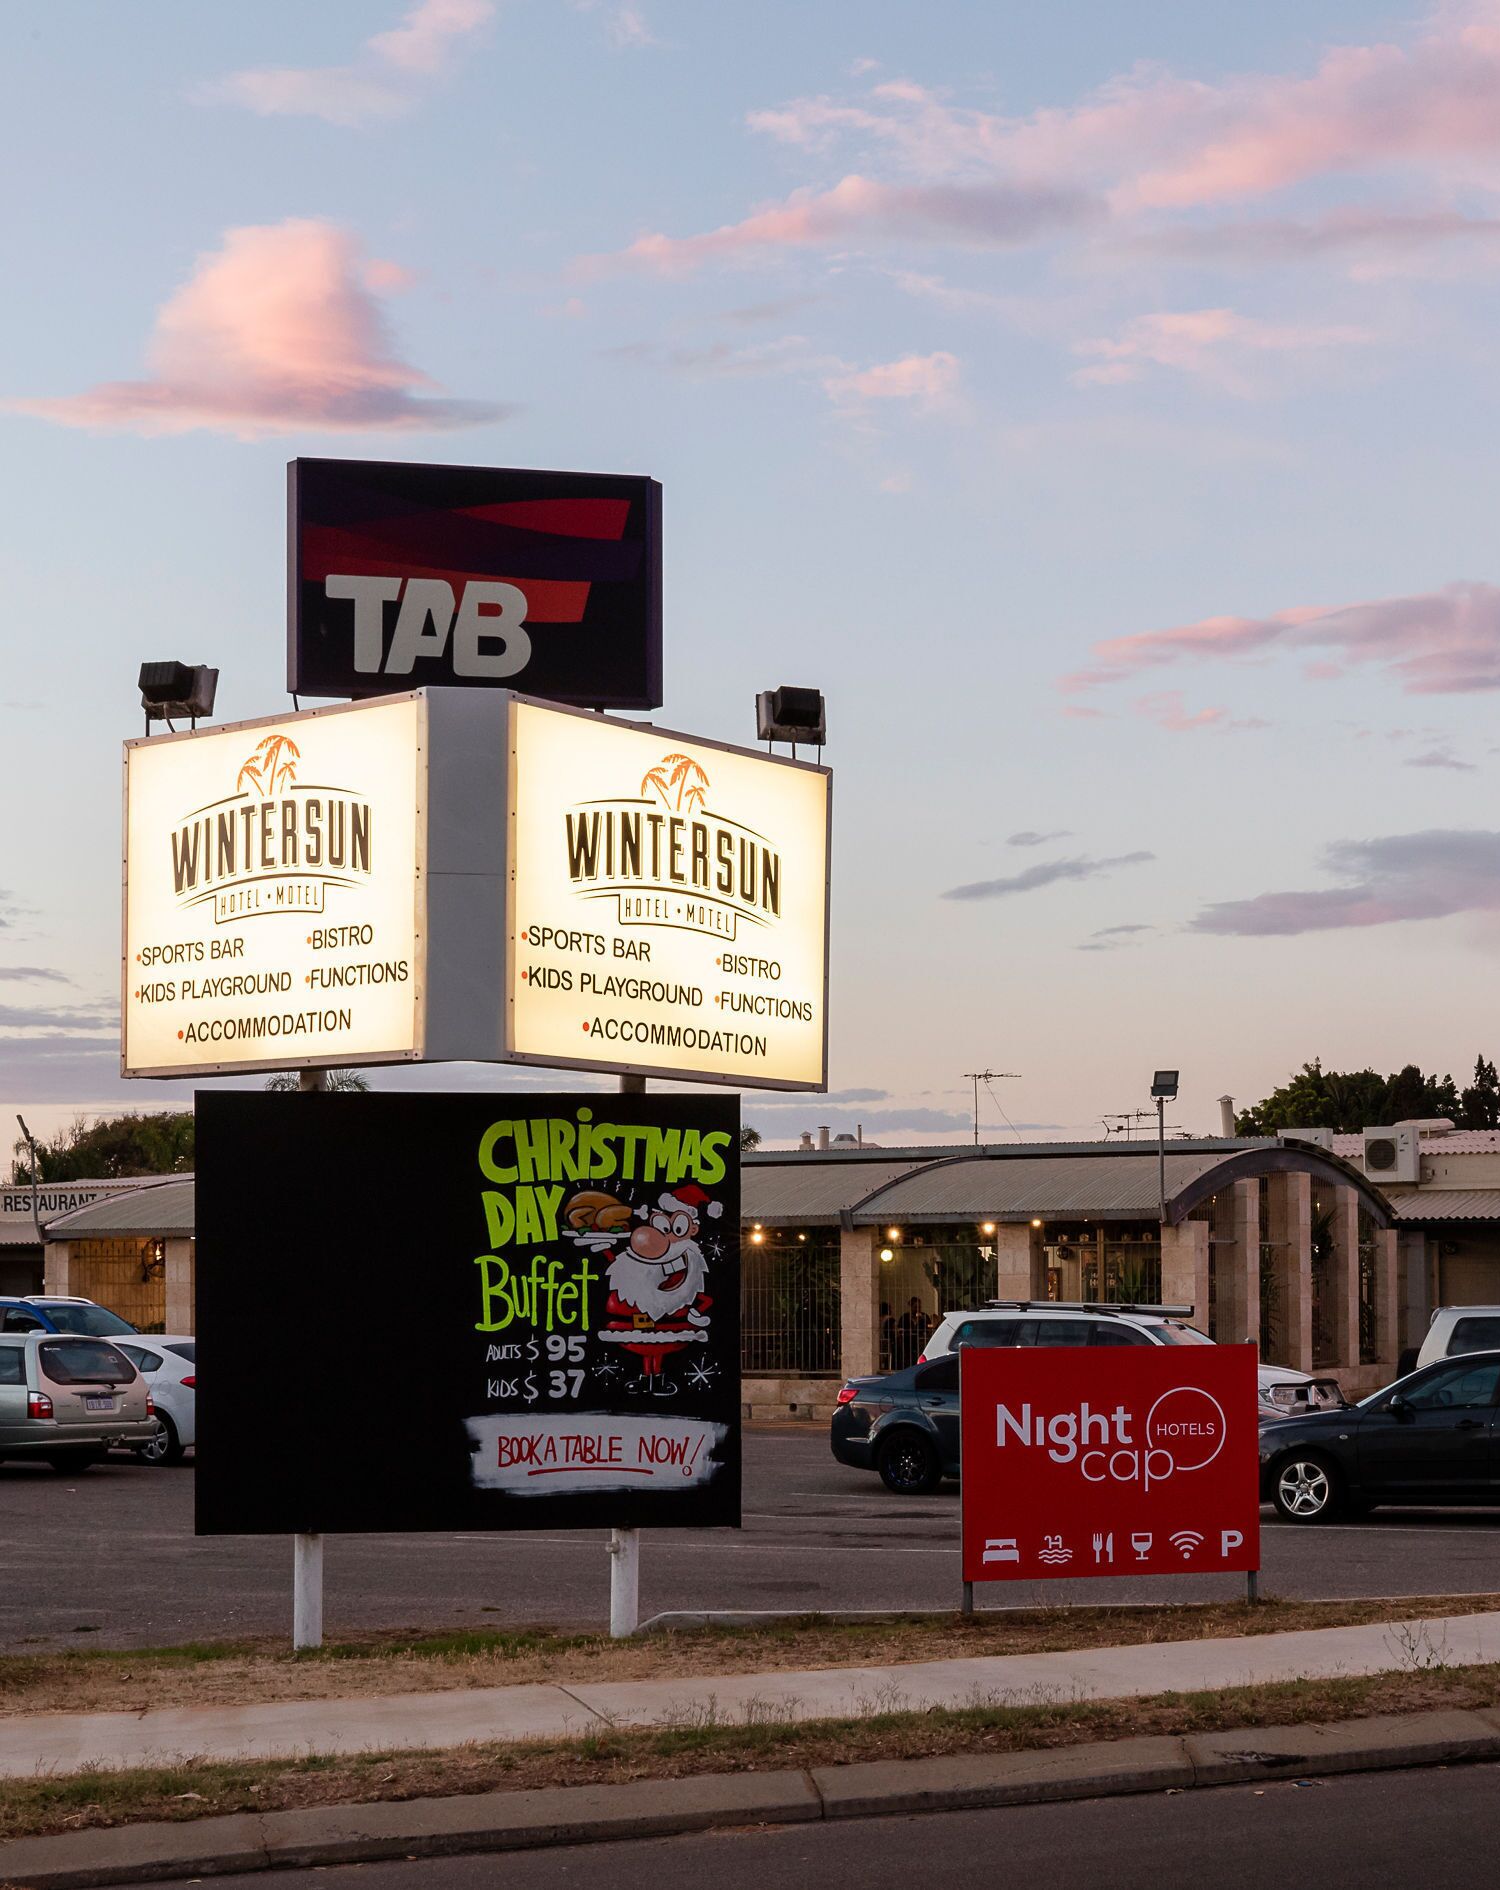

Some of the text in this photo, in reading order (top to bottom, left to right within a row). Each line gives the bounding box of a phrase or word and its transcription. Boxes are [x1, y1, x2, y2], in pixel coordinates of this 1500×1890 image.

[325, 574, 532, 678] TAB
[171, 798, 372, 896] WINTERSUN
[565, 811, 781, 918] WINTERSUN
[220, 886, 318, 915] HOTEL MOTEL
[625, 898, 731, 933] HOTEL MOTEL
[141, 938, 244, 966] SPORTS BAR
[312, 924, 373, 949] BISTRO
[528, 926, 651, 962] SPORTS BAR
[310, 960, 409, 989] FUNCTIONS
[722, 953, 781, 980] BISTRO
[140, 971, 292, 1004] KIDS PLAYGROUND
[528, 966, 703, 1007] KIDS PLAYGROUND
[721, 991, 813, 1022] FUNCTIONS
[185, 1008, 352, 1044] ACCOMMODATION
[590, 1017, 767, 1057] ACCOMMODATION
[3, 1193, 97, 1212] RESAURANT
[481, 1185, 566, 1249] DAY
[474, 1255, 599, 1332] Buffet
[486, 1343, 522, 1363] ADULTS
[487, 1378, 519, 1399] KIDS
[1156, 1422, 1215, 1436] HOTELS
[559, 1435, 622, 1463] TABLE
[638, 1434, 705, 1477] NOW!
[1080, 1449, 1174, 1492] cap
